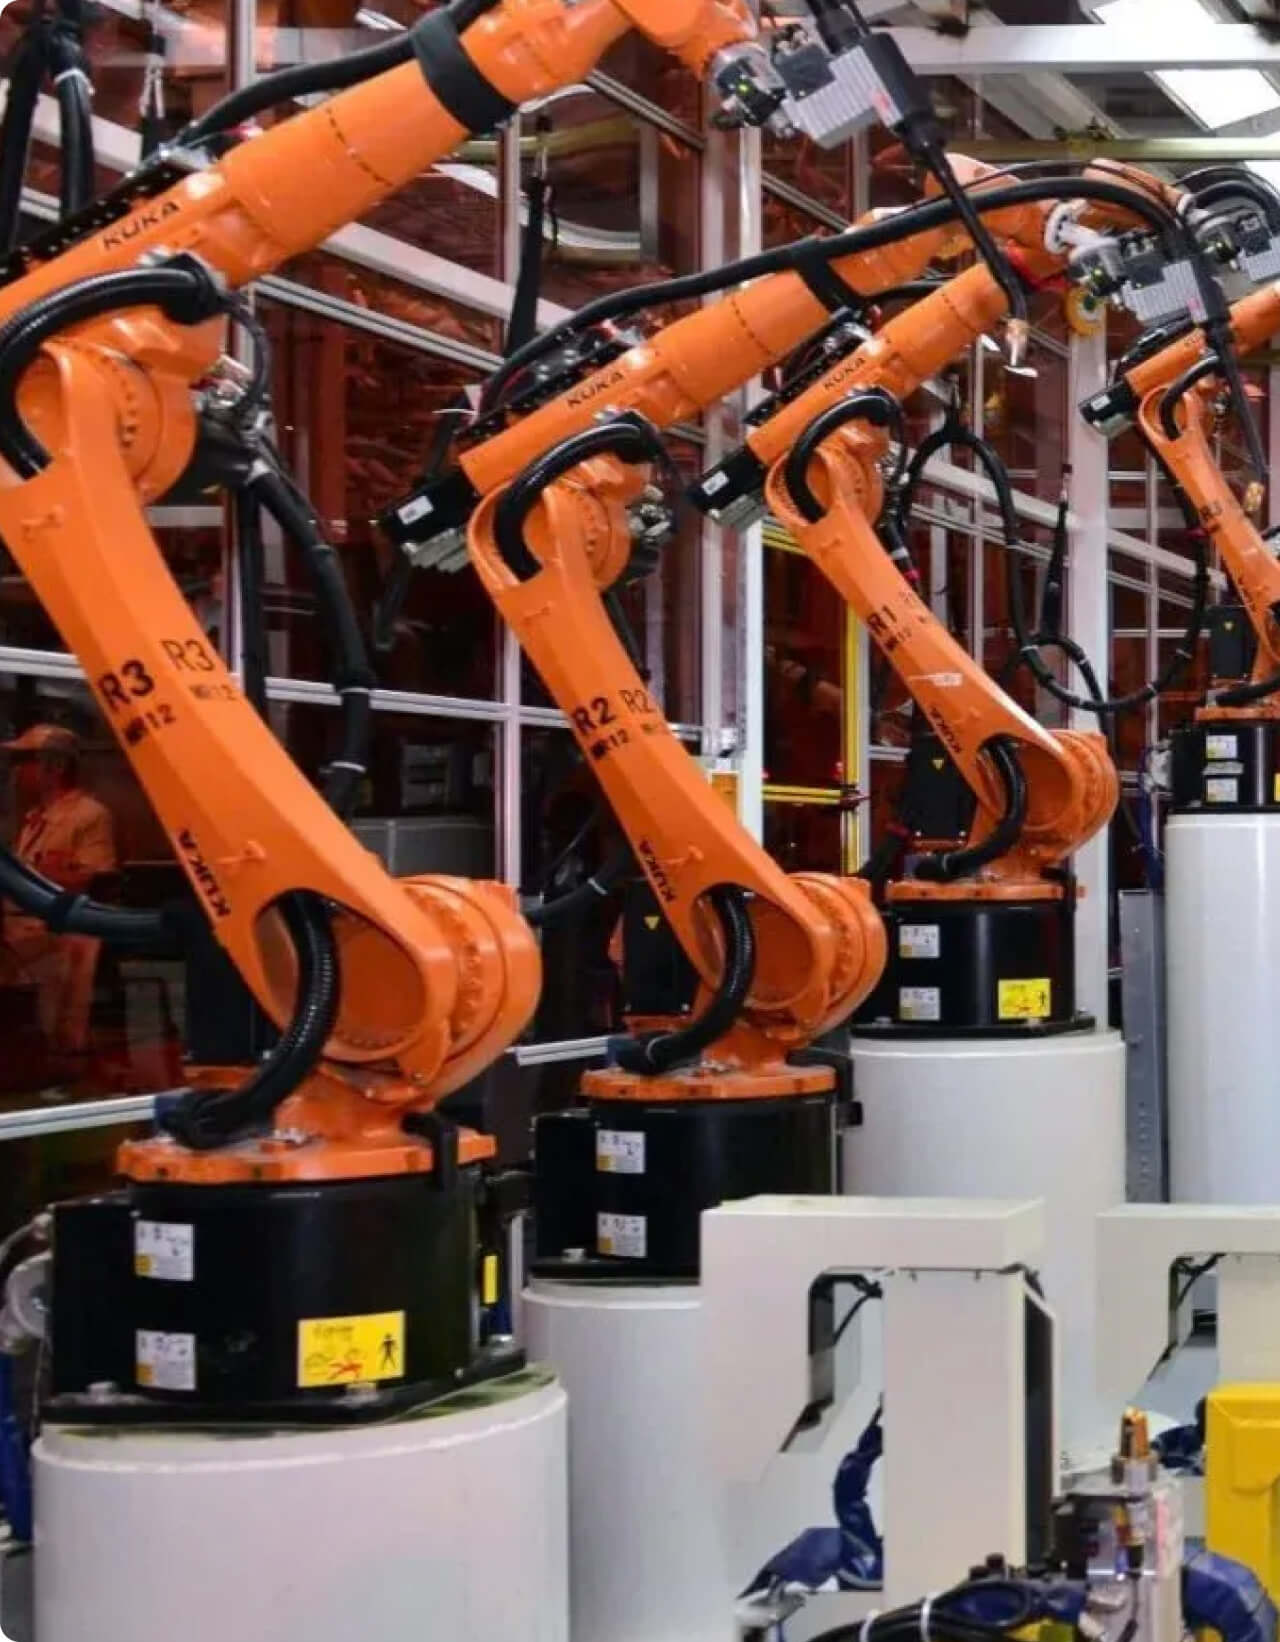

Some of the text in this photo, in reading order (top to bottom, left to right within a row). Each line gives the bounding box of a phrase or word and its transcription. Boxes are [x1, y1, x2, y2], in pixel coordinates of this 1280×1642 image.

[102, 201, 179, 250] KUKA
[567, 372, 624, 408] KUKA
[823, 357, 866, 390] KUKA
[865, 605, 897, 636] R1
[161, 639, 214, 671] R3
[98, 660, 154, 712] R3
[618, 689, 656, 713] R2
[570, 697, 617, 736] R2
[179, 828, 232, 918] KUKA
[639, 838, 677, 903] KUKA
